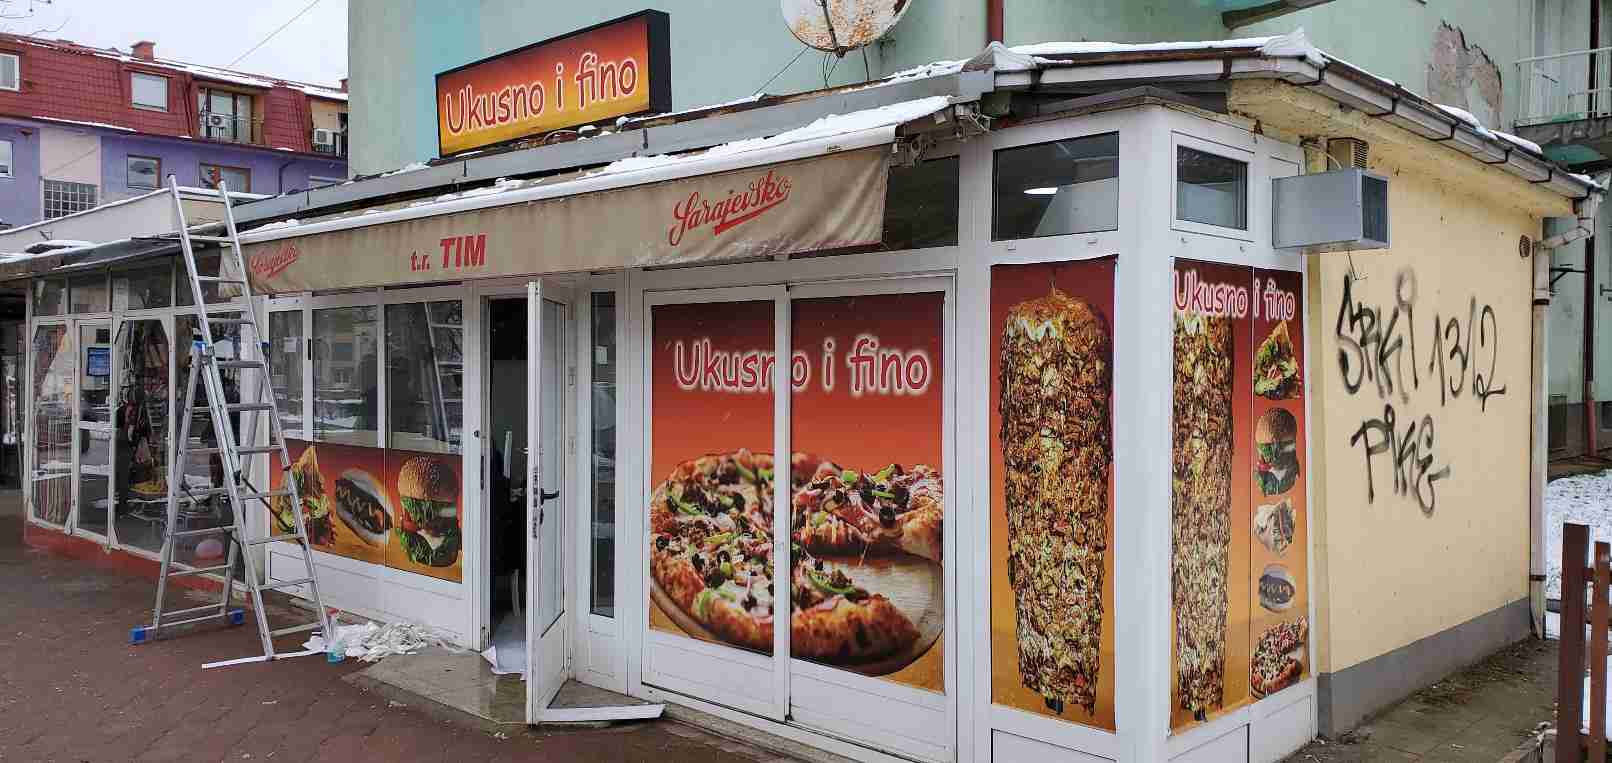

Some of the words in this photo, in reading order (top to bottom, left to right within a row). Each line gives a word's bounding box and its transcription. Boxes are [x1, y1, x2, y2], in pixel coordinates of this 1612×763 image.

[445, 81, 545, 136] Ukusno
[555, 62, 564, 110] i
[575, 51, 638, 109] fino
[410, 251, 431, 272] t.r.
[440, 234, 487, 269] TIM
[1174, 269, 1249, 319] Ukusno
[1254, 278, 1261, 318] i
[1263, 277, 1297, 322] fino
[674, 338, 810, 390] Ukusno
[823, 339, 836, 390] i
[848, 335, 930, 396] fino
